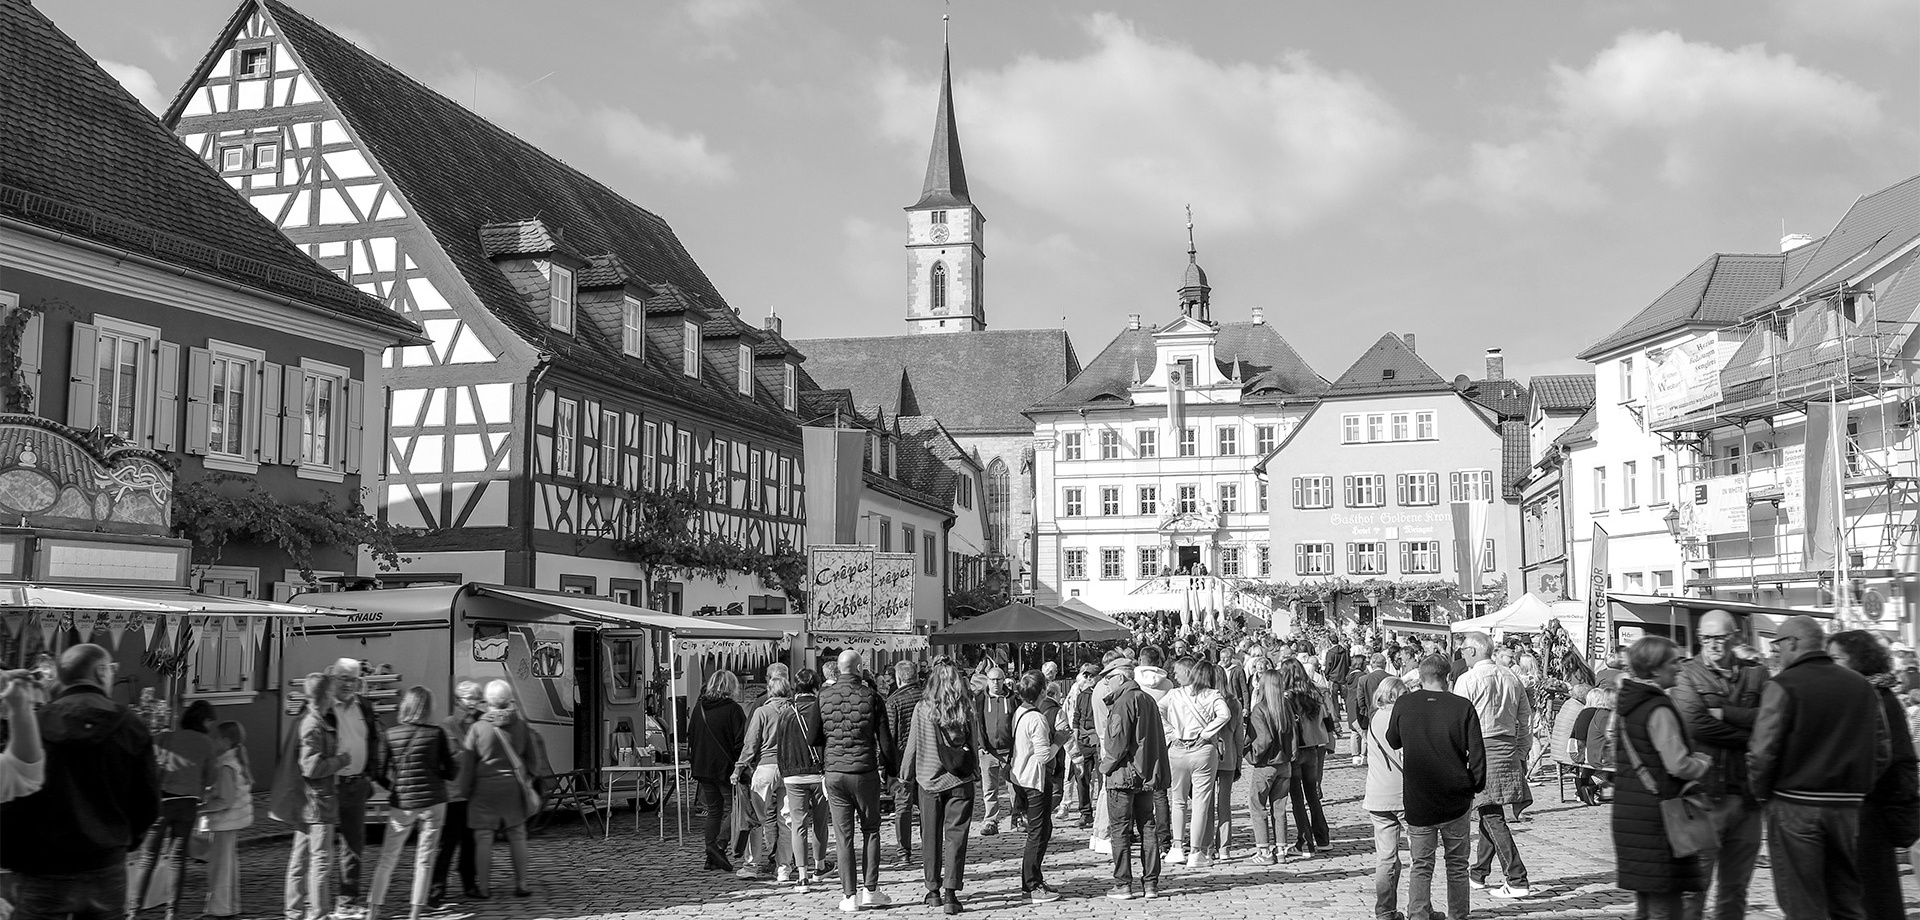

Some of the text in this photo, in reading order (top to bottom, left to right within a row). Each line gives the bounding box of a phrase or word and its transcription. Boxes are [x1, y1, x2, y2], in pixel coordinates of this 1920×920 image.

[1330, 510, 1453, 526] Gasthof Goldene Kron
[816, 561, 869, 586] Crêpes
[347, 612, 383, 622] KNAUS
[816, 595, 870, 620] Kaffee
[1591, 567, 1606, 660] FÜR IHR GEHÖR
[844, 636, 871, 645] Kaffee
[873, 637, 887, 646] Eis
